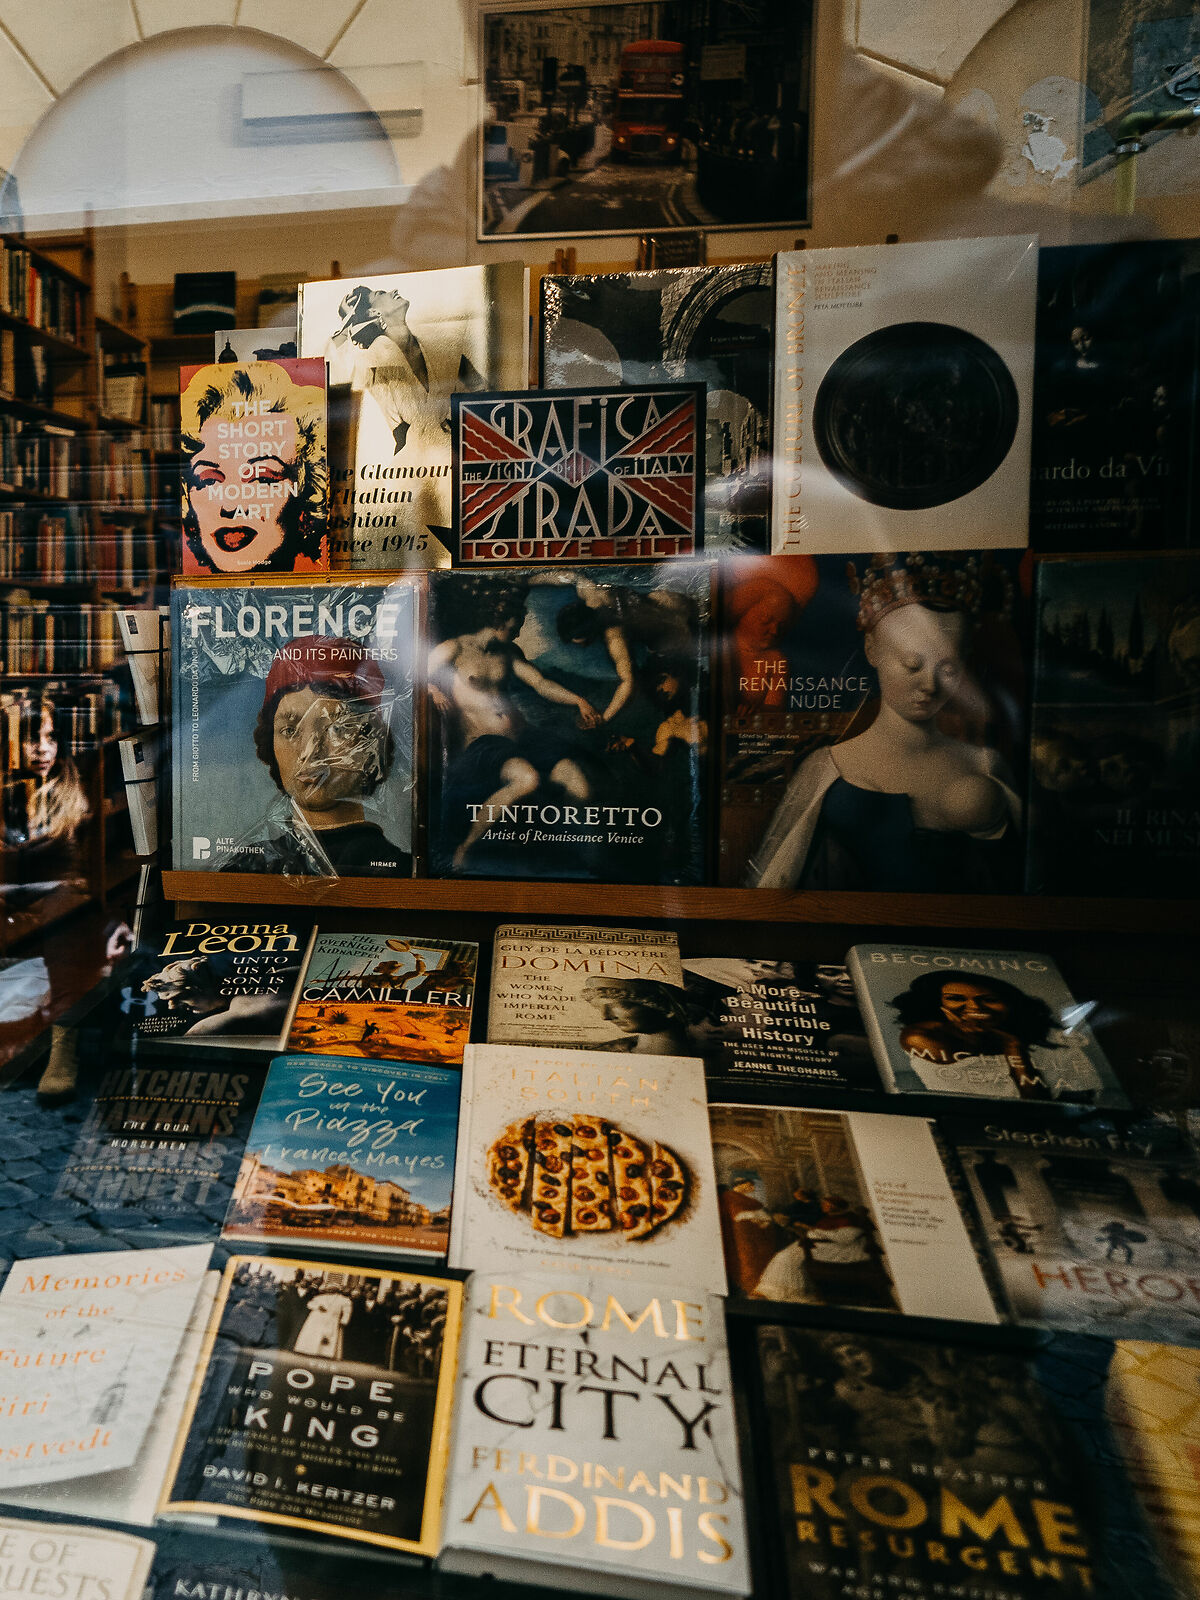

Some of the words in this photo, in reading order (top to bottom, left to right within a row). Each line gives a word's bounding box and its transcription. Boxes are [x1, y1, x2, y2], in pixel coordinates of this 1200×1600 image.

[232, 400, 271, 417] THE
[218, 420, 287, 439] SHORT
[218, 441, 287, 459] STORY
[238, 463, 266, 479] OF
[331, 464, 353, 482] he
[360, 463, 451, 481] Glamour
[464, 472, 481, 481] THE
[614, 465, 630, 475] OF
[1100, 457, 1126, 477] da
[208, 481, 298, 500] MODERN
[343, 490, 413, 505] Italian
[233, 504, 273, 521] ART
[331, 512, 397, 529] ashion
[483, 482, 664, 540] STRADA
[381, 534, 428, 552] 1945
[191, 604, 400, 638] FLORENCE
[274, 649, 301, 660] AND
[306, 649, 326, 660] ITS
[331, 649, 398, 661] PAINTERS
[754, 660, 788, 674] THE
[739, 677, 869, 691] RENAISSANCE
[790, 694, 841, 709] NUDE
[466, 804, 662, 827] TINTORETTO
[482, 829, 516, 840] Artist
[518, 829, 533, 844] of
[533, 831, 603, 843] Renaissance
[607, 832, 644, 844] Venice
[184, 923, 288, 937] Donna
[352, 935, 378, 944] THE
[158, 931, 300, 957] Leon
[317, 946, 381, 959] KIDNAPPER
[320, 939, 387, 953] OVERNIGHT
[233, 955, 288, 965] UNTO
[502, 955, 668, 976] DOMINA
[869, 952, 1048, 972] BECOMING
[236, 966, 259, 975] US
[222, 976, 263, 986] SON
[270, 976, 284, 985] IS
[510, 983, 563, 992] WOMEN
[219, 986, 280, 996] GIVEN
[303, 987, 471, 1007] CAMILLERI
[736, 985, 745, 994] A
[750, 984, 800, 998] More
[504, 1002, 568, 1012] IMPERIAL
[726, 996, 817, 1014] Beautiful
[720, 1014, 747, 1023] and
[751, 1013, 831, 1031] Terrible
[742, 1027, 814, 1046] History
[733, 1061, 773, 1071] JEANNE
[101, 1069, 249, 1100] HITCHENS
[299, 1073, 363, 1098] See
[377, 1081, 427, 1105] You
[511, 1069, 659, 1091] ITALIAN
[521, 1087, 649, 1107] SOUTH
[361, 1103, 389, 1115] the
[123, 1121, 146, 1130] THE
[155, 1122, 190, 1132] FOUR
[285, 1108, 424, 1149] Piazza
[984, 1124, 1100, 1148] Stephen
[111, 1139, 188, 1151] HORSEMEN
[366, 1153, 445, 1173] Mayes
[20, 1267, 186, 1294] Memories
[46, 1305, 68, 1319] of
[79, 1304, 115, 1318] the
[488, 1284, 706, 1341] ROME
[484, 1340, 722, 1395] ETERNAL
[248, 1361, 395, 1403] POPE
[287, 1394, 363, 1416] WOULD
[377, 1409, 406, 1423] BE
[473, 1373, 721, 1450] CITY
[244, 1407, 380, 1448] KING
[808, 1446, 892, 1470] PETER
[471, 1446, 729, 1505] FERDINAND
[203, 1464, 269, 1486] DAVID
[296, 1480, 397, 1510] KERTZER
[789, 1464, 1087, 1558] ROME
[460, 1480, 734, 1565] ADDIS
[29, 1538, 80, 1565] OF
[796, 1518, 1094, 1592] RESURGENT
